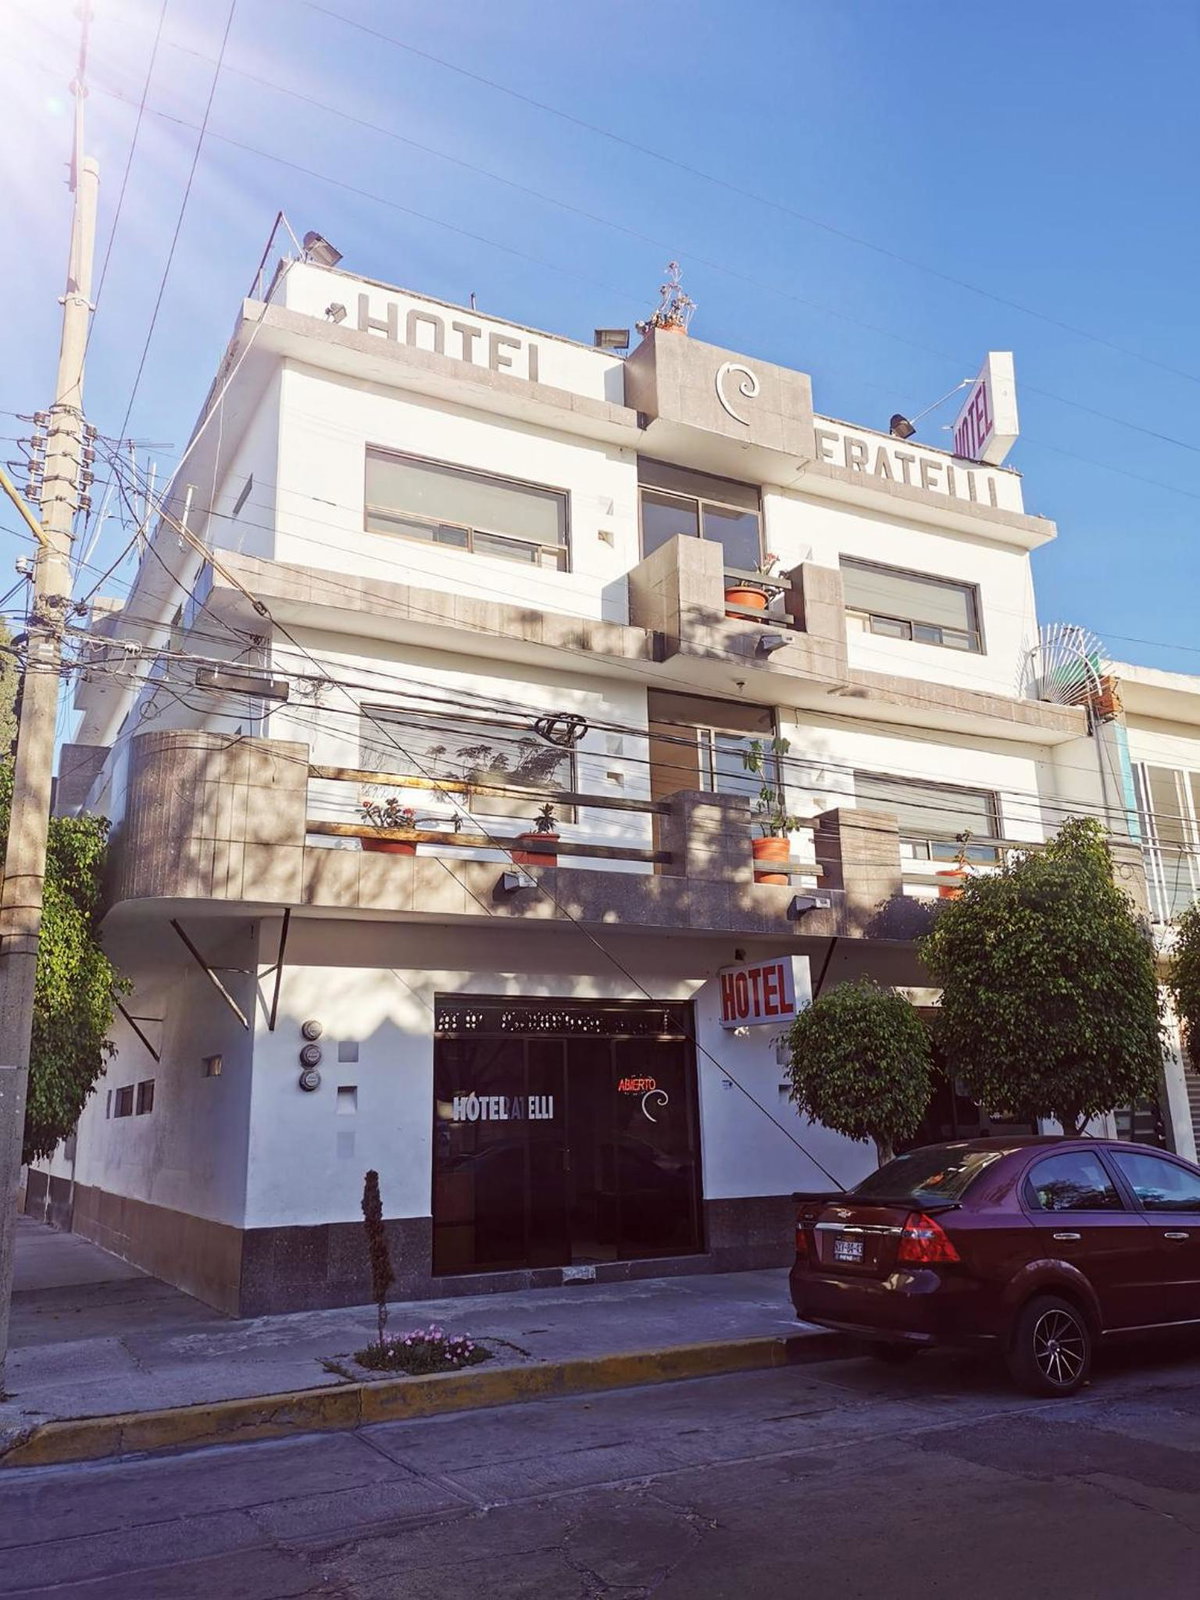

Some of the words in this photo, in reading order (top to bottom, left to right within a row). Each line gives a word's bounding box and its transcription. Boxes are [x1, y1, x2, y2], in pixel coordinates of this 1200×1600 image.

[955, 383, 993, 458] HOTEL
[721, 964, 794, 1021] HOTEL
[617, 1077, 657, 1092] ABIERTO
